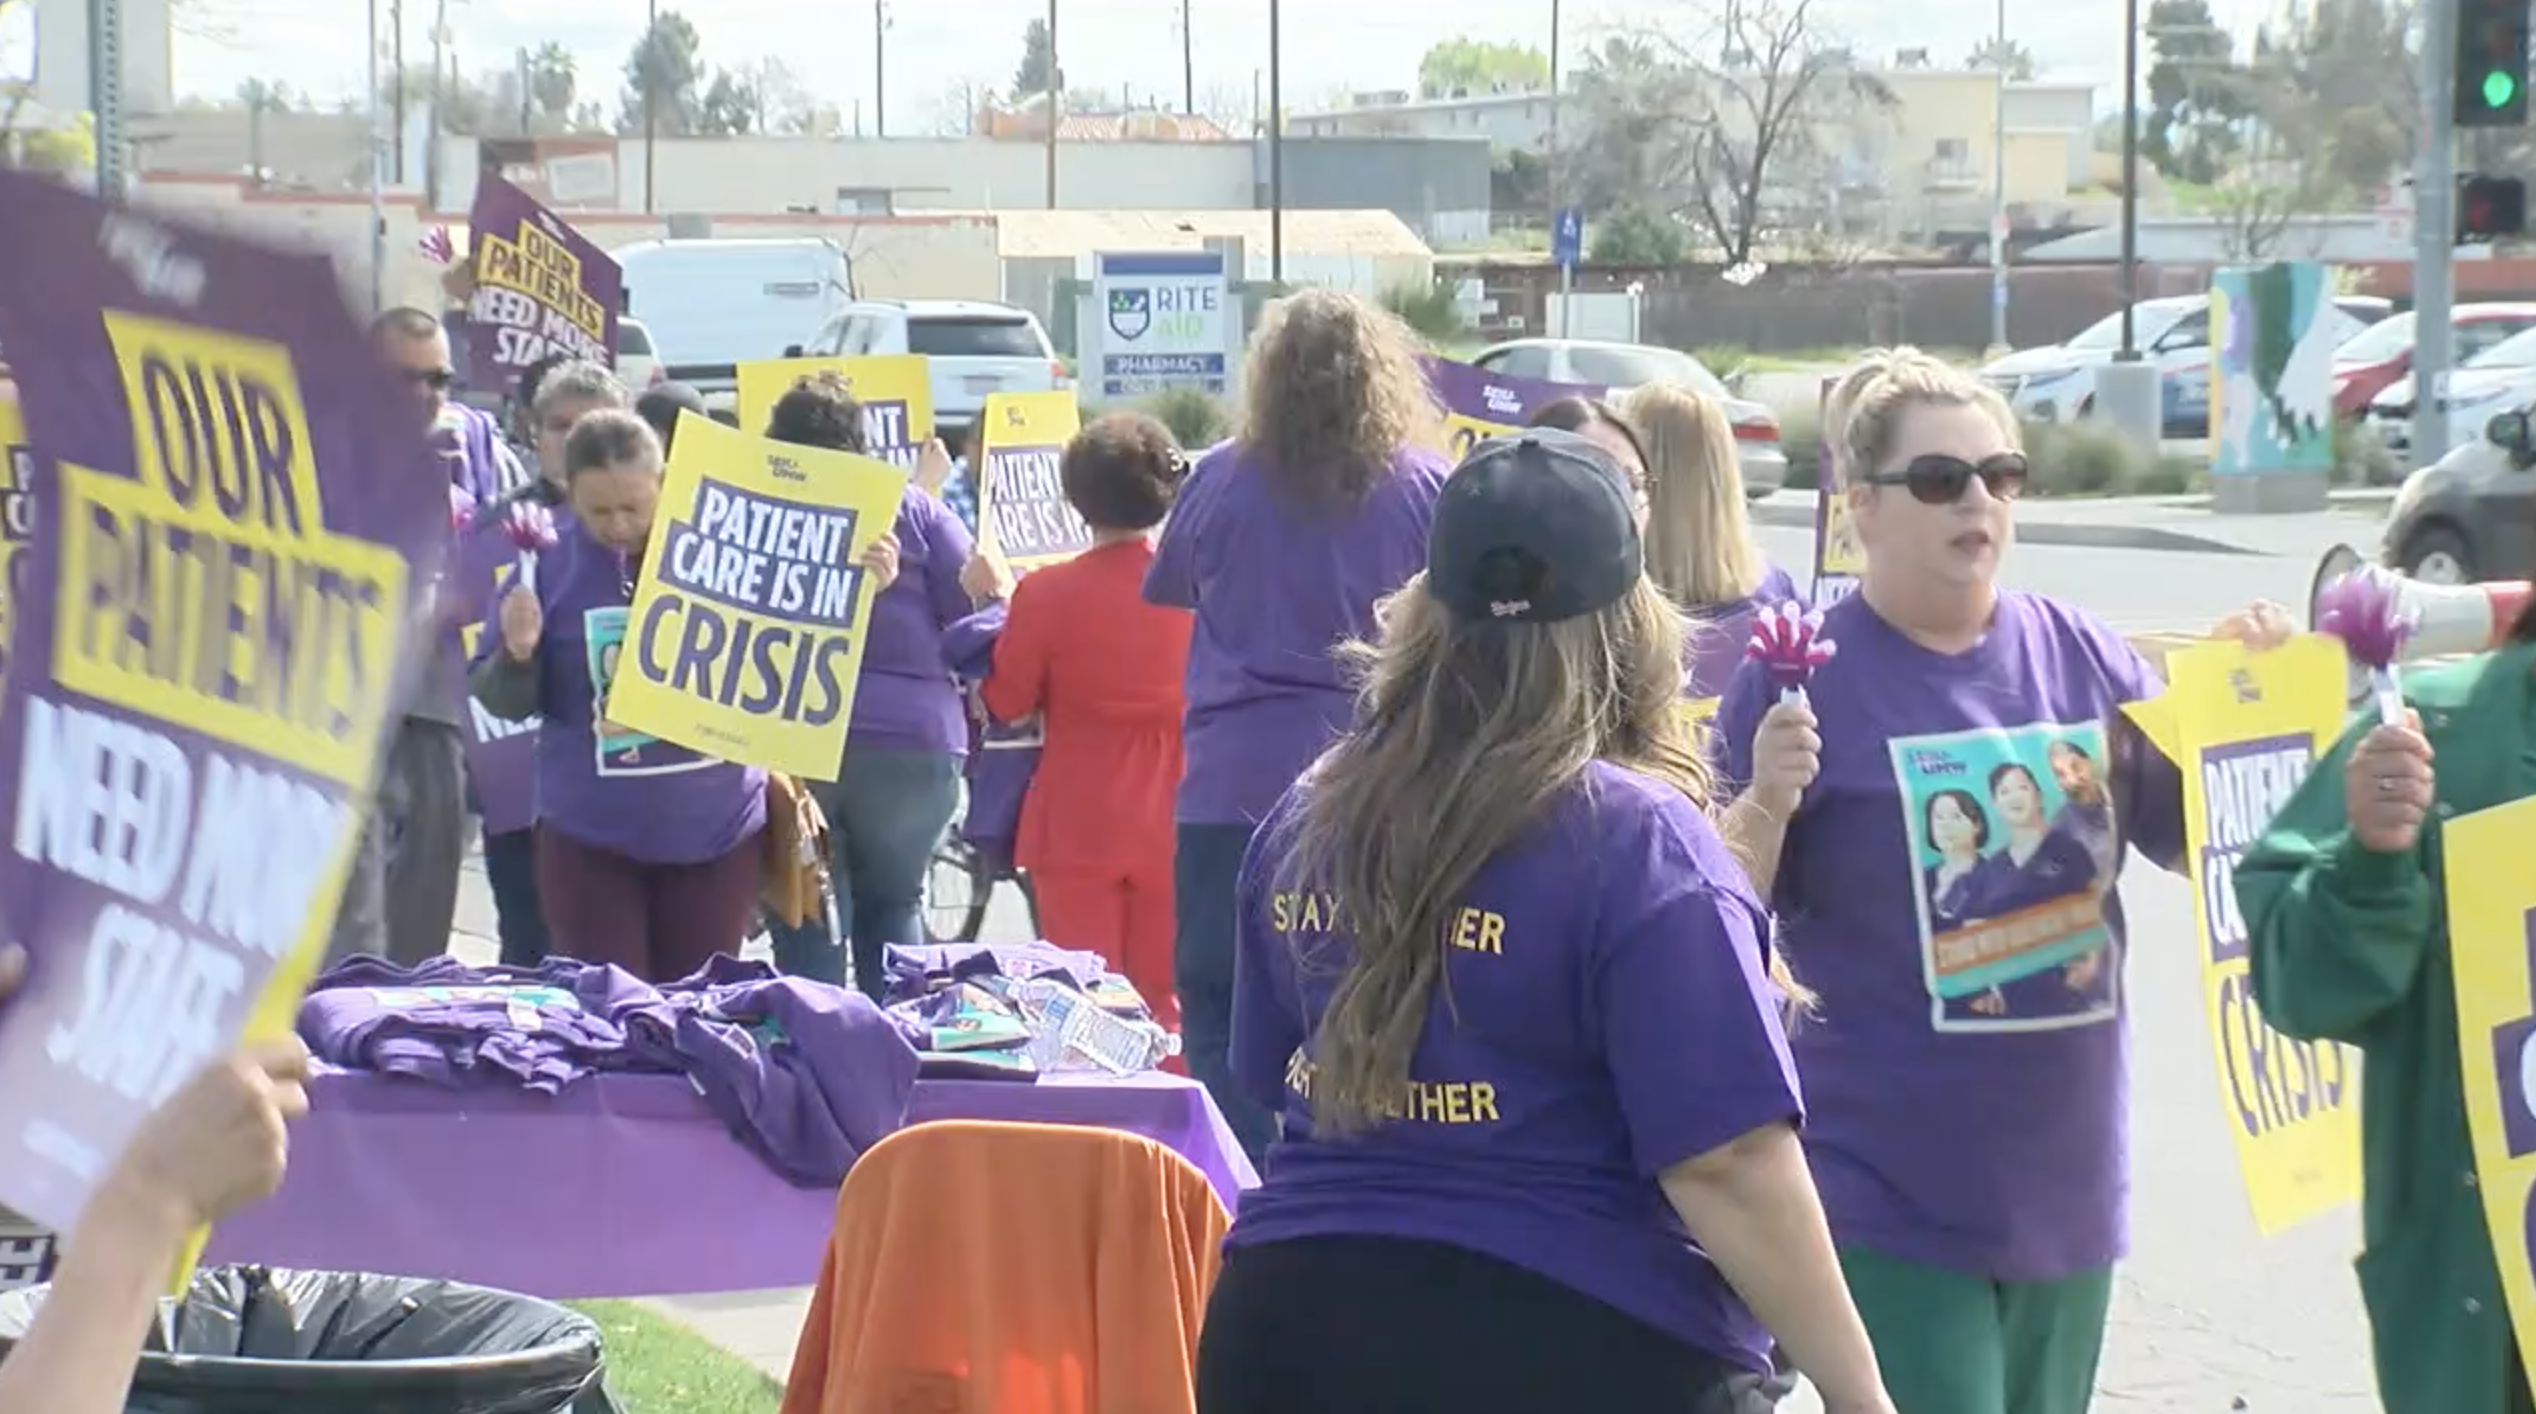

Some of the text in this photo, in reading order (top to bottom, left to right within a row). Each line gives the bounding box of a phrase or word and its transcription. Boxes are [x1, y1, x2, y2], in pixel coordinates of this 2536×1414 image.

[525, 228, 574, 281] OUR
[488, 243, 599, 332] PATIENTS
[1157, 285, 1218, 312] RITE
[1117, 356, 1206, 375] PHARMACY
[141, 352, 303, 538] OUR
[988, 452, 1063, 503] PATIENT
[699, 486, 848, 564] PATIENT
[992, 501, 1037, 552] ARE
[1034, 500, 1064, 550] IS
[671, 532, 853, 620] CARE IS IN
[638, 594, 850, 727] CRISIS
[14, 694, 193, 905] NEED
[1274, 893, 1343, 932] STAY
